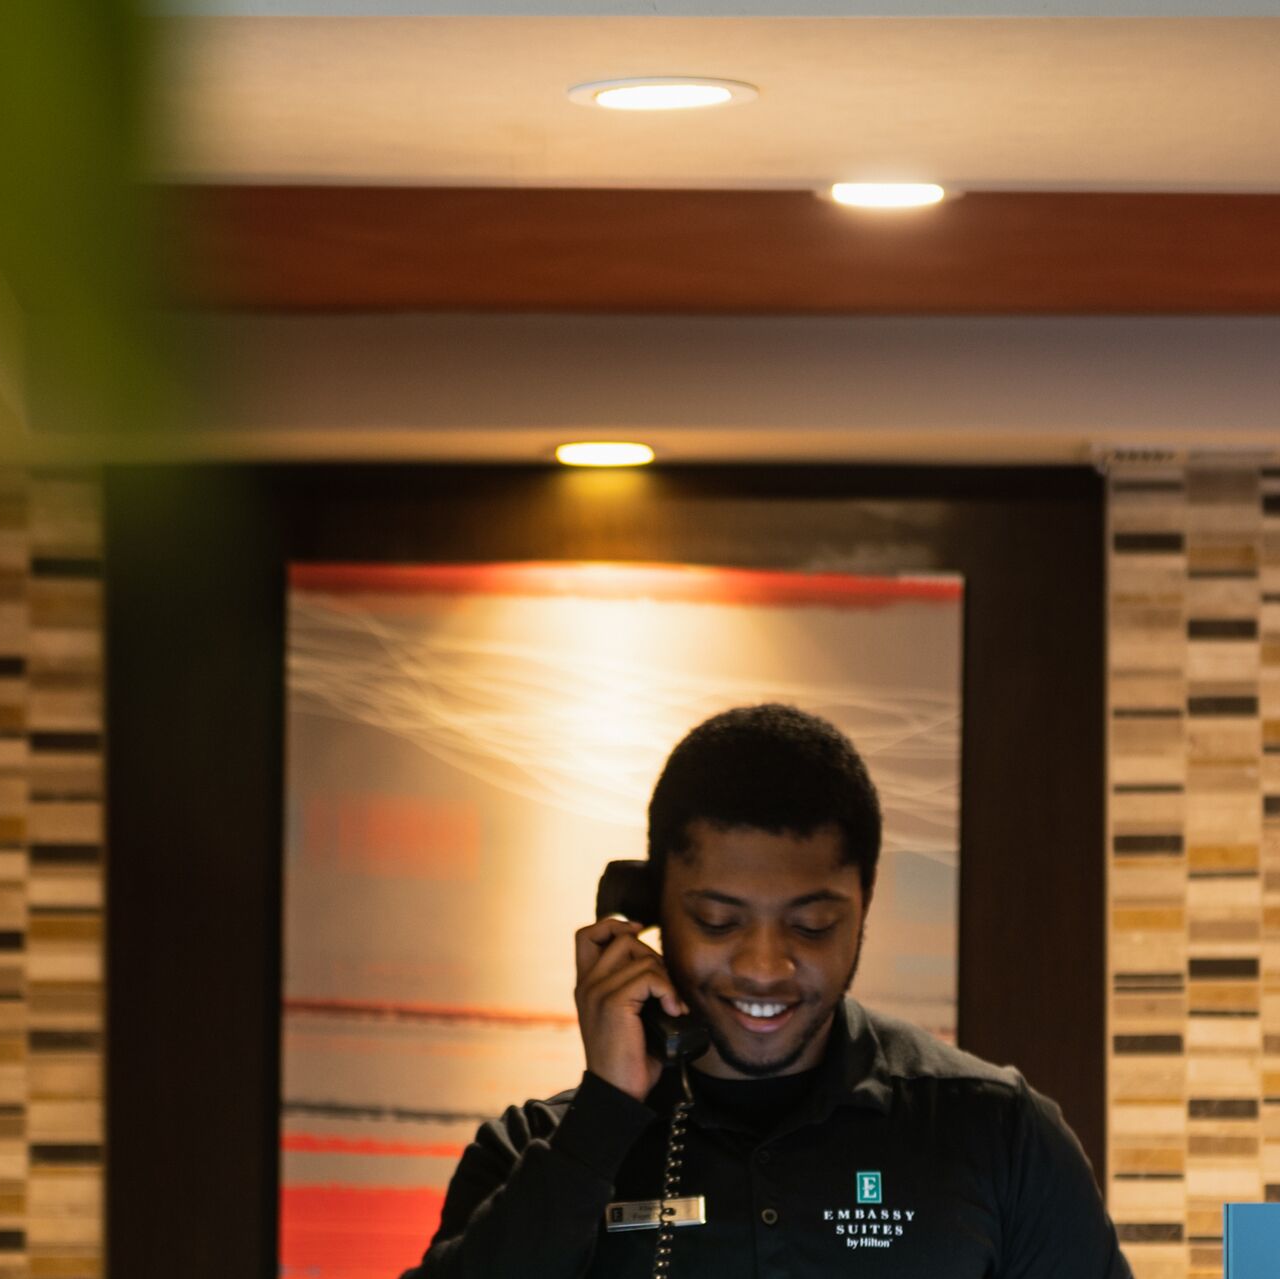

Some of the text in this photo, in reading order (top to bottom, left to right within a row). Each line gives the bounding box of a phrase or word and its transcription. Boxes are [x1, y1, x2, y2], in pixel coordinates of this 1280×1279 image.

[862, 1176, 877, 1199] E
[823, 1209, 915, 1221] EMBASSY
[836, 1223, 903, 1236] SUITES
[847, 1237, 890, 1249] by Hilton
